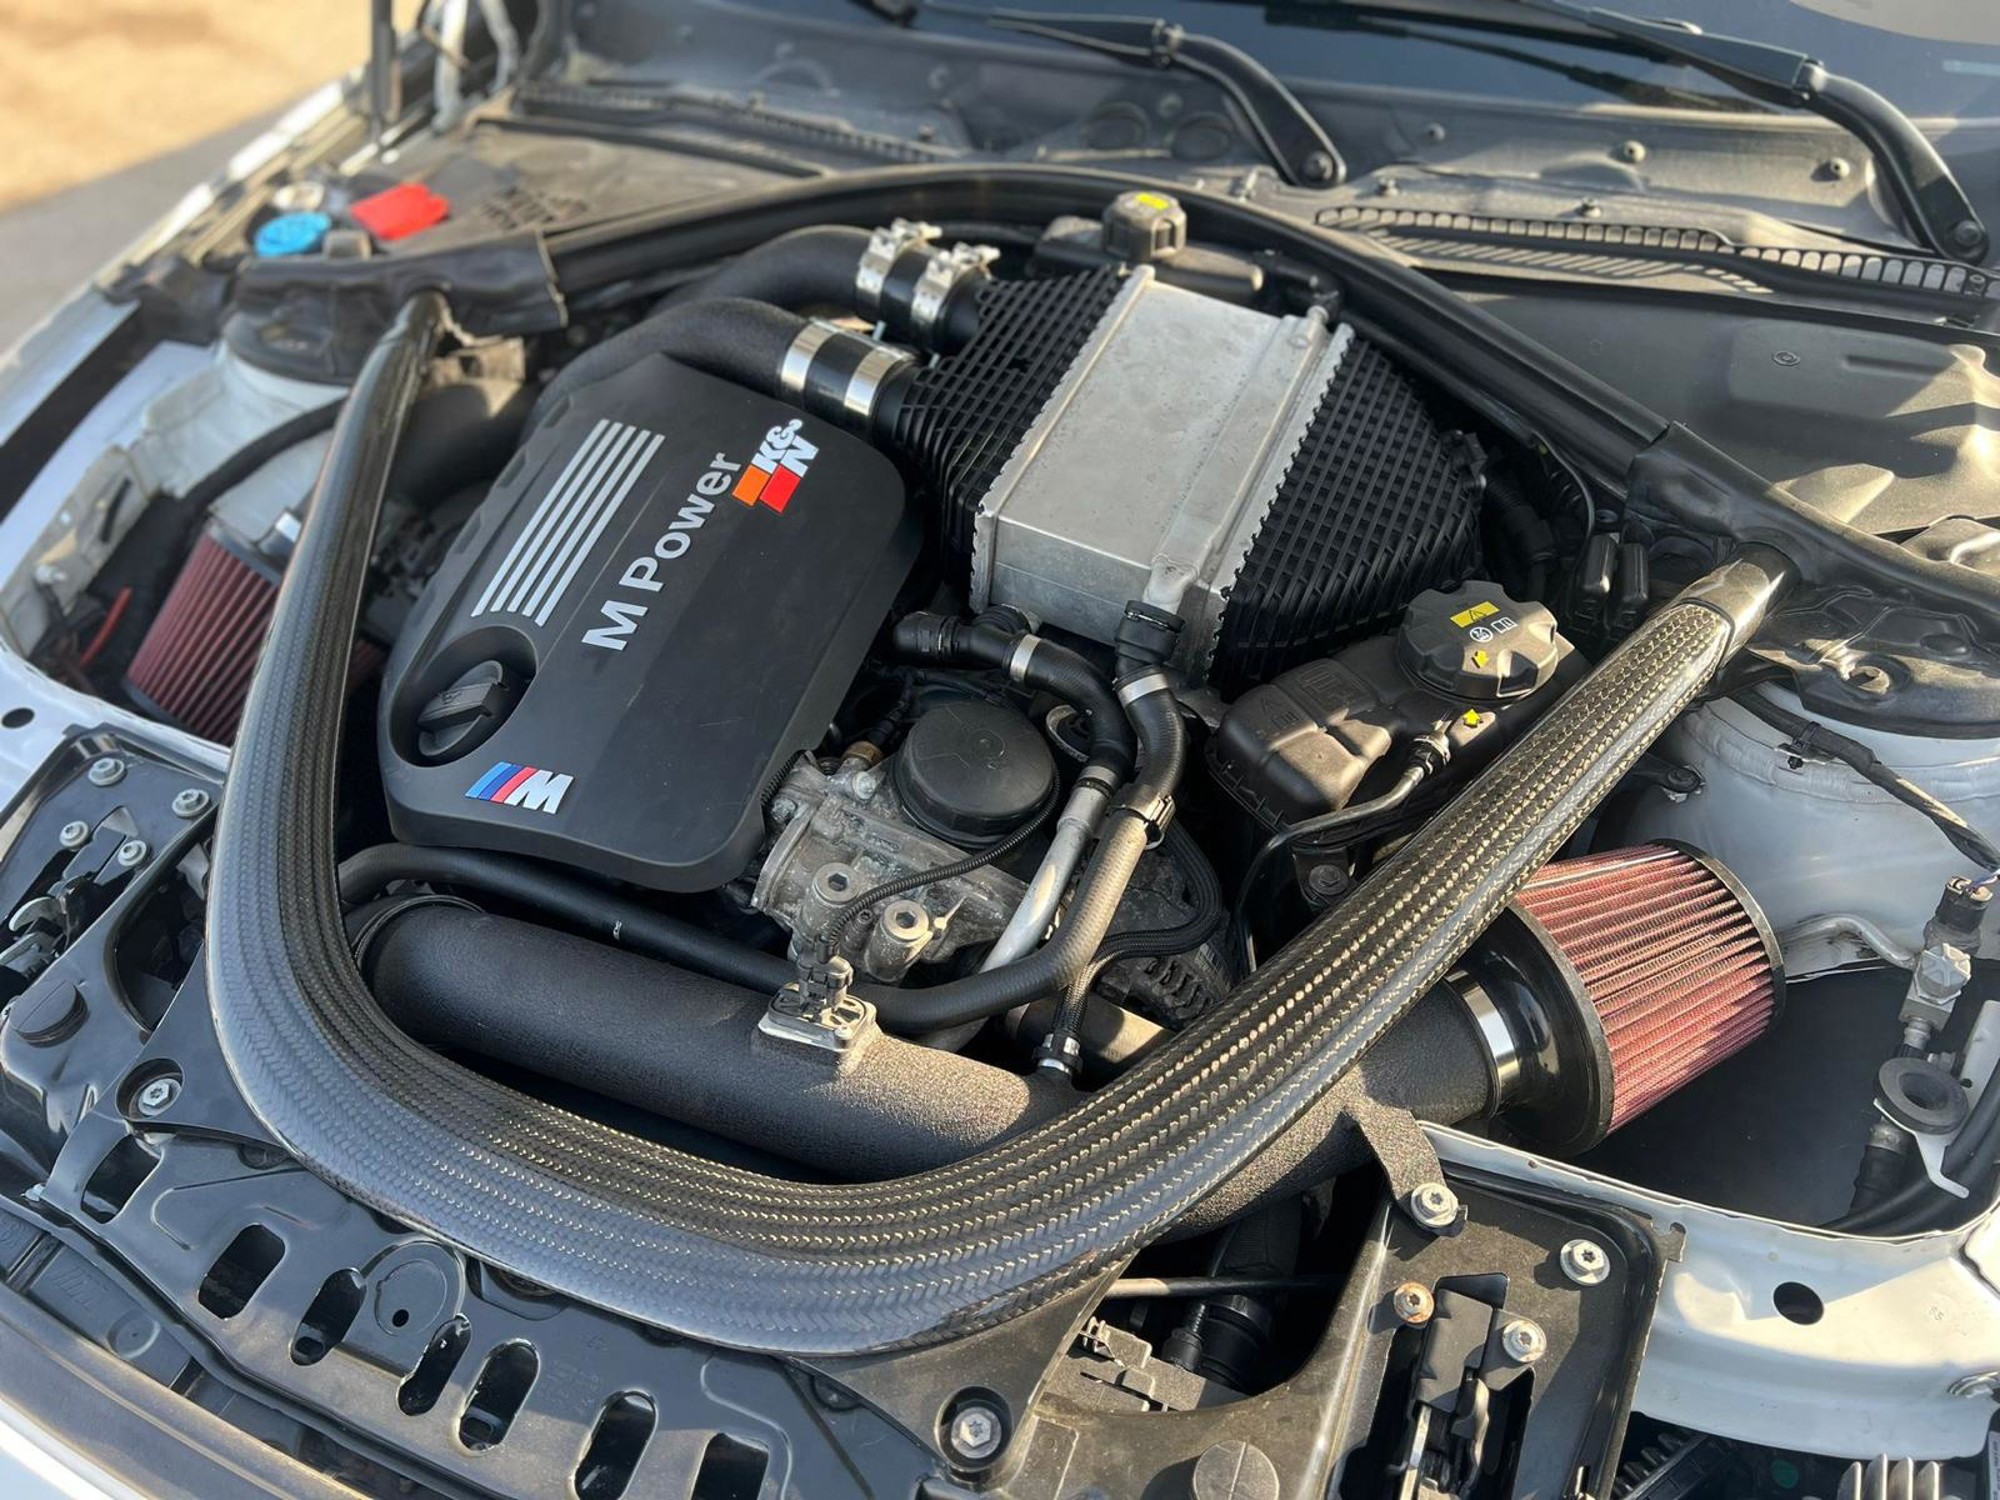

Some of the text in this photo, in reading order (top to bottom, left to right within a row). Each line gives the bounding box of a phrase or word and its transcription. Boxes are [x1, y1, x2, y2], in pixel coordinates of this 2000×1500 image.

[751, 418, 819, 478] K&N
[581, 452, 742, 650] M Power
[503, 769, 574, 815] M
